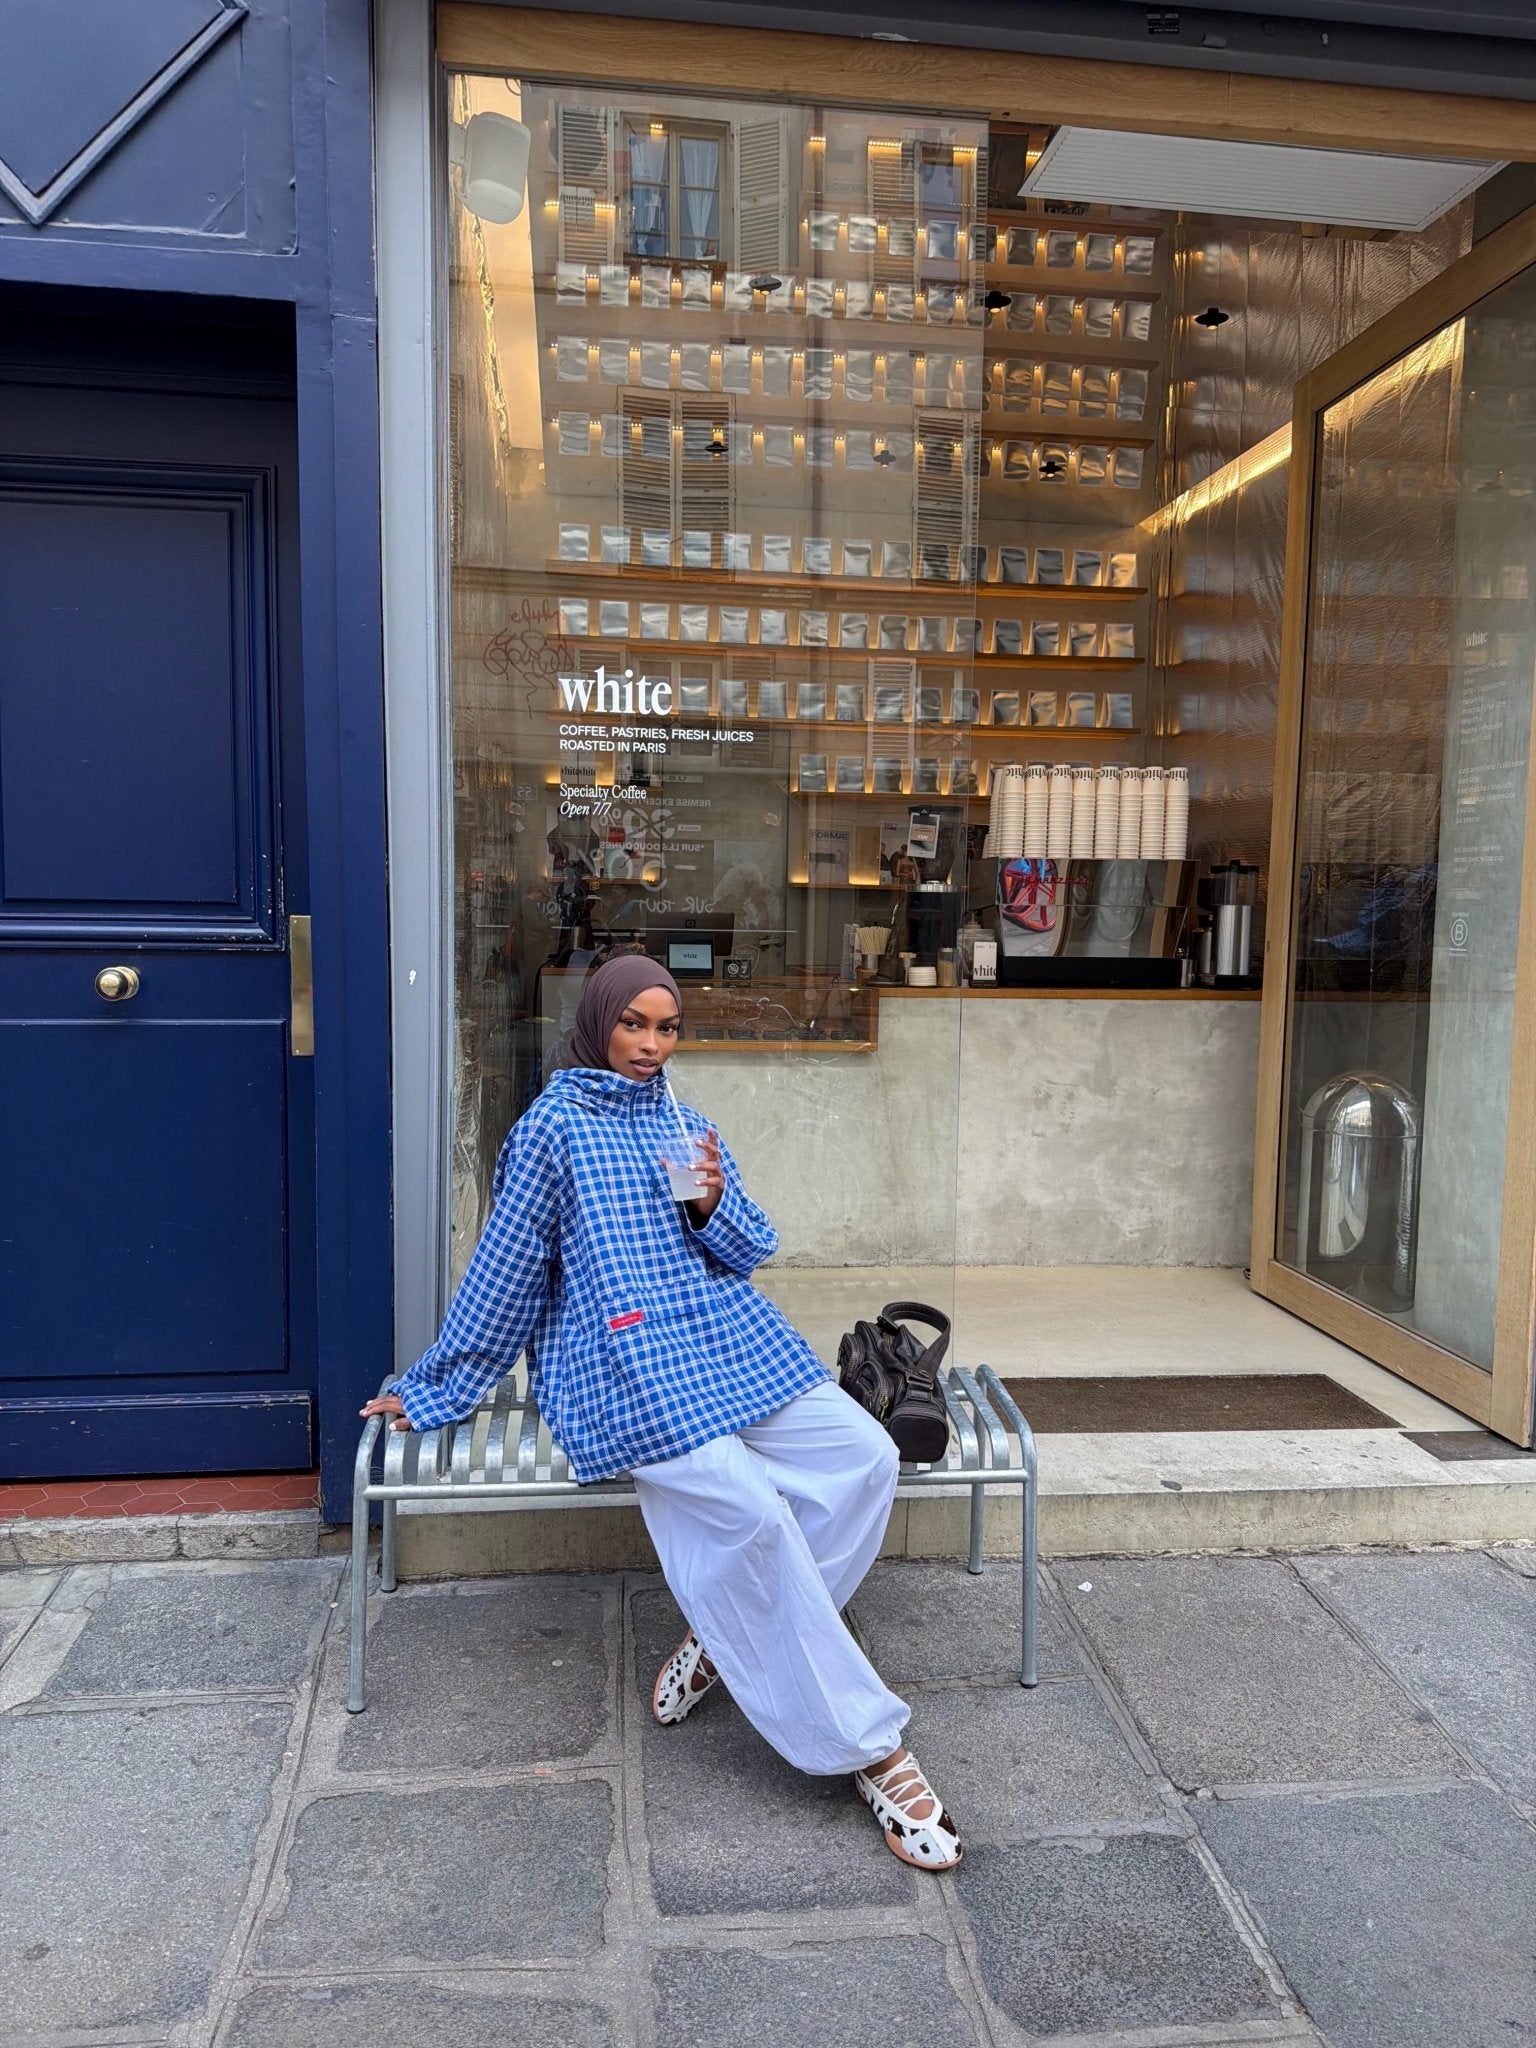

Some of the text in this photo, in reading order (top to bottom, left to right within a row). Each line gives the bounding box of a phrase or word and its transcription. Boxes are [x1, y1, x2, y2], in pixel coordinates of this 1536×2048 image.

[558, 665, 673, 716] white
[559, 724, 754, 742] COFFEE, PASTRIES, FRESH JUICES
[559, 739, 667, 753] ROASTED IN PARIS
[559, 782, 647, 802] Specialty Coffee
[559, 800, 613, 818] Open 7/7
